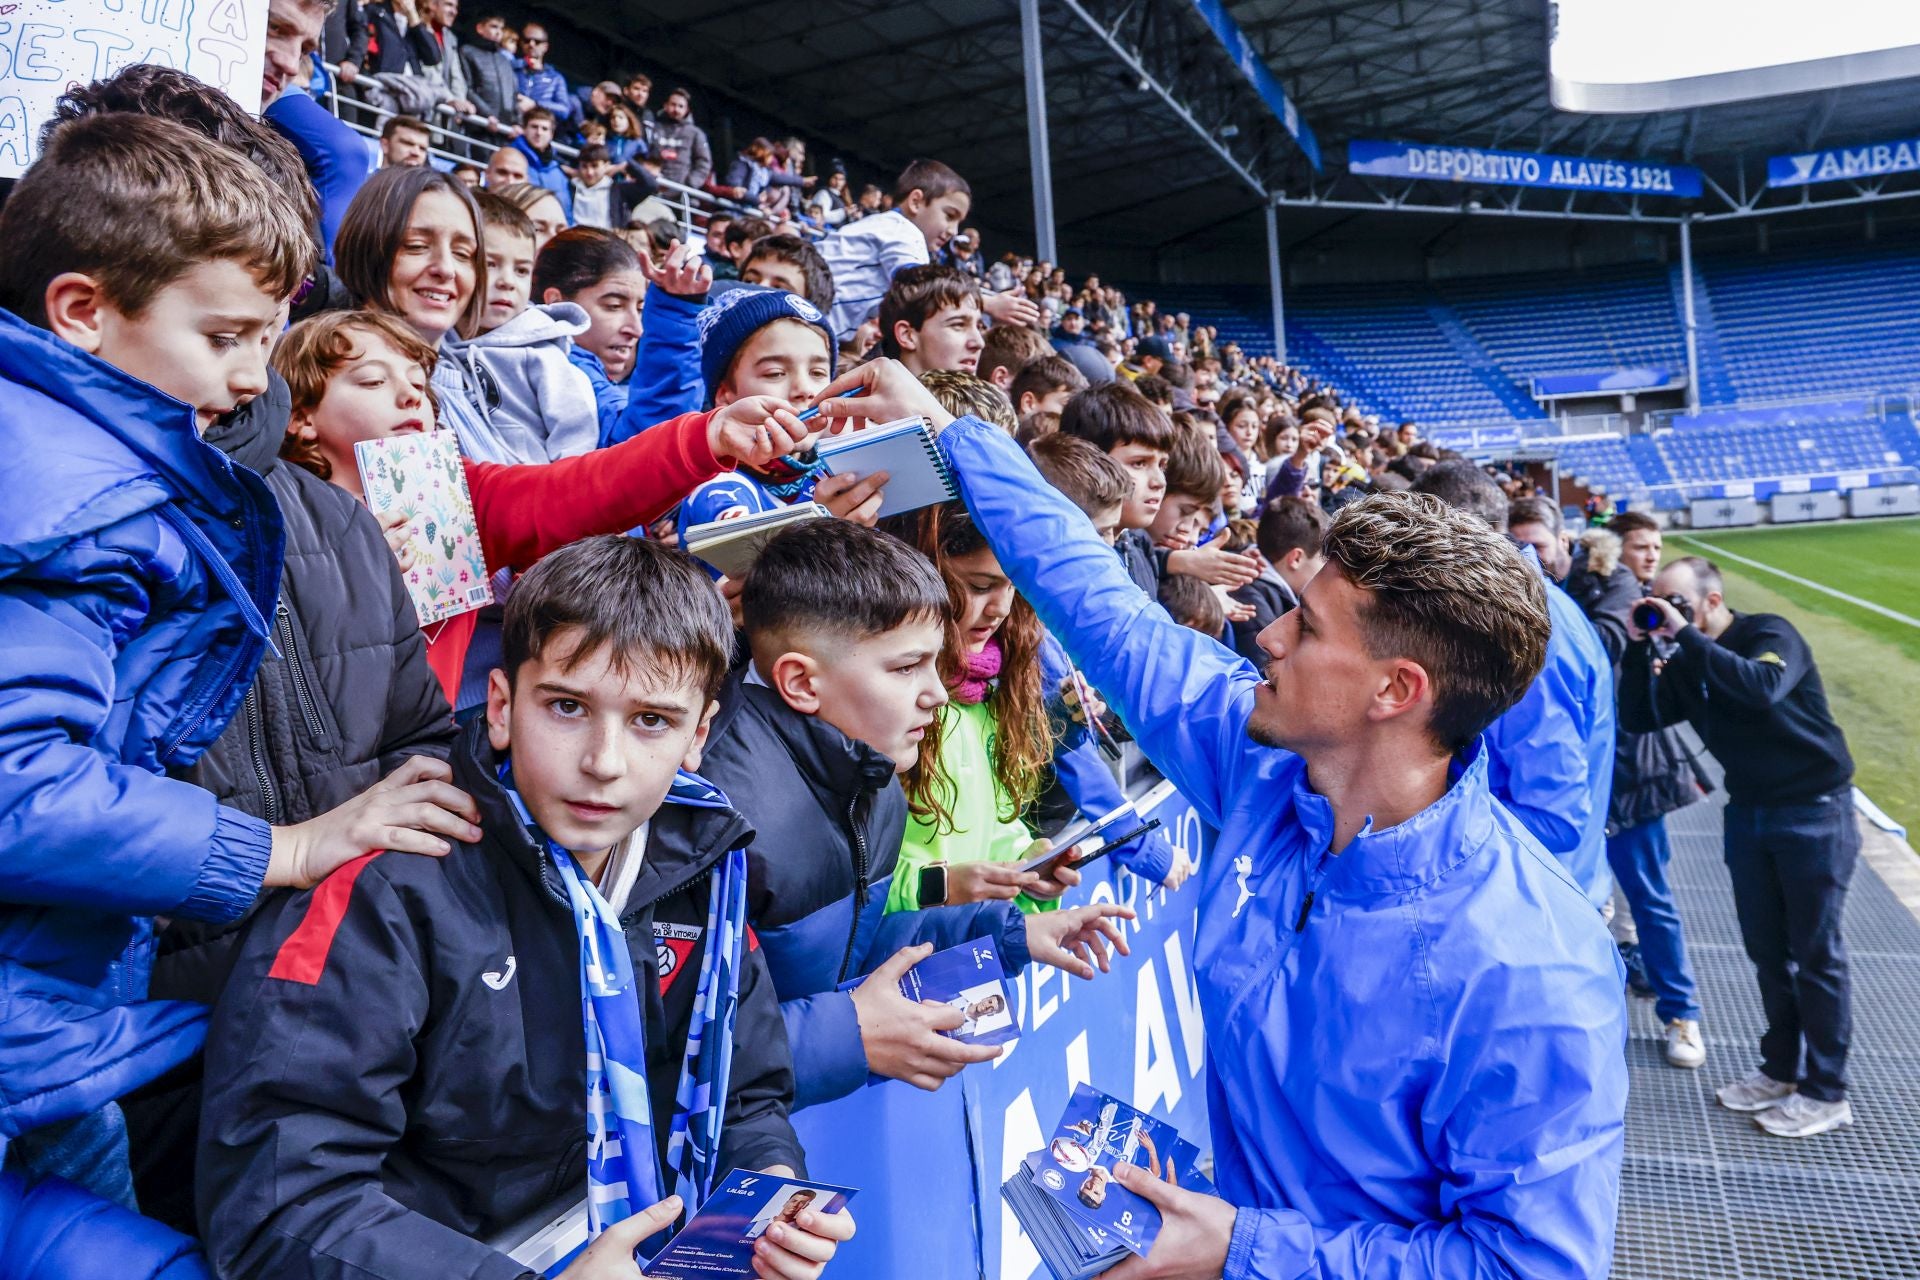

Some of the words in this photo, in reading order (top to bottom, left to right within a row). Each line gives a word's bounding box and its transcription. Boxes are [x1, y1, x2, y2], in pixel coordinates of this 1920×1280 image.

[1817, 141, 1920, 178] AMBA
[1407, 148, 1540, 182] DEPORTIVO
[1550, 159, 1628, 188] ALAVÉS
[1630, 166, 1674, 191] 1921
[673, 930, 698, 938] VITORIA
[726, 1187, 748, 1195] LALIGA
[1121, 1210, 1133, 1226] 8
[1113, 1221, 1133, 1235] BLANCO
